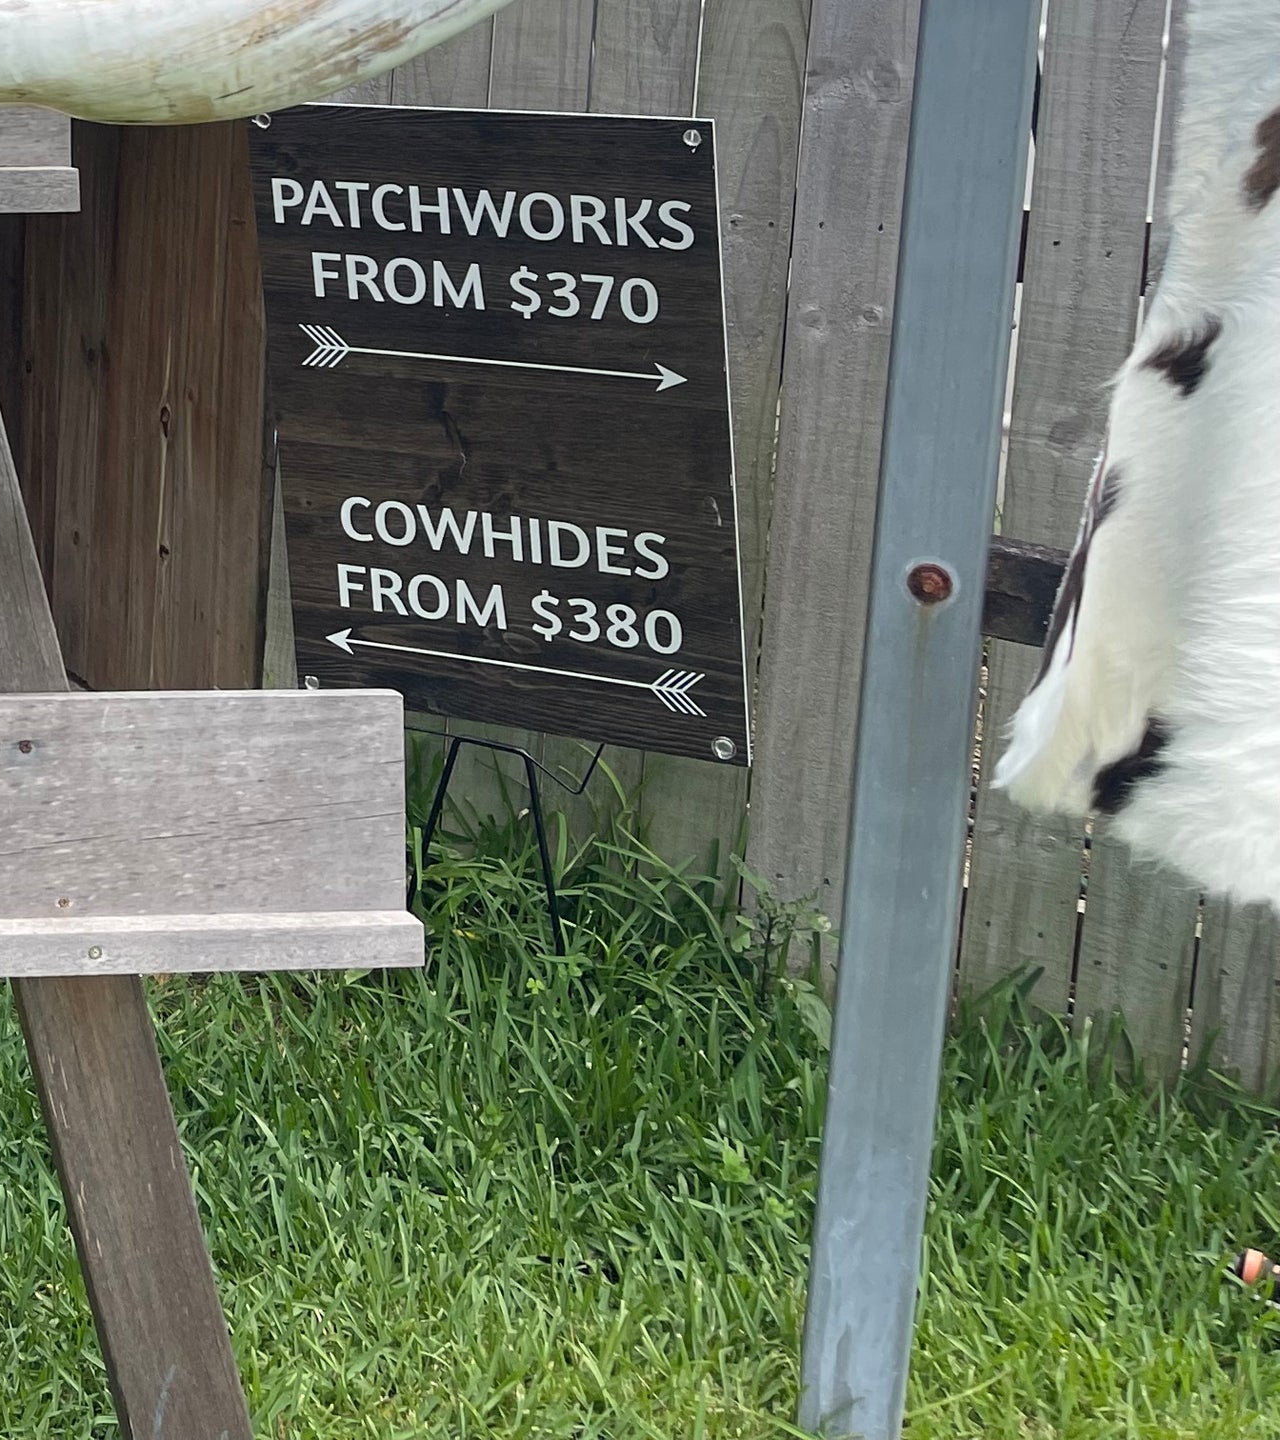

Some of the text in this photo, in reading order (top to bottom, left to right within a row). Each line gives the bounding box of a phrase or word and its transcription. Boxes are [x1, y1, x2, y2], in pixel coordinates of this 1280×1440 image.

[270, 177, 695, 251] PATCHWORKS
[311, 252, 660, 325] FROM $370
[339, 496, 670, 581] COWHIDES
[336, 563, 684, 656] FROM $380
